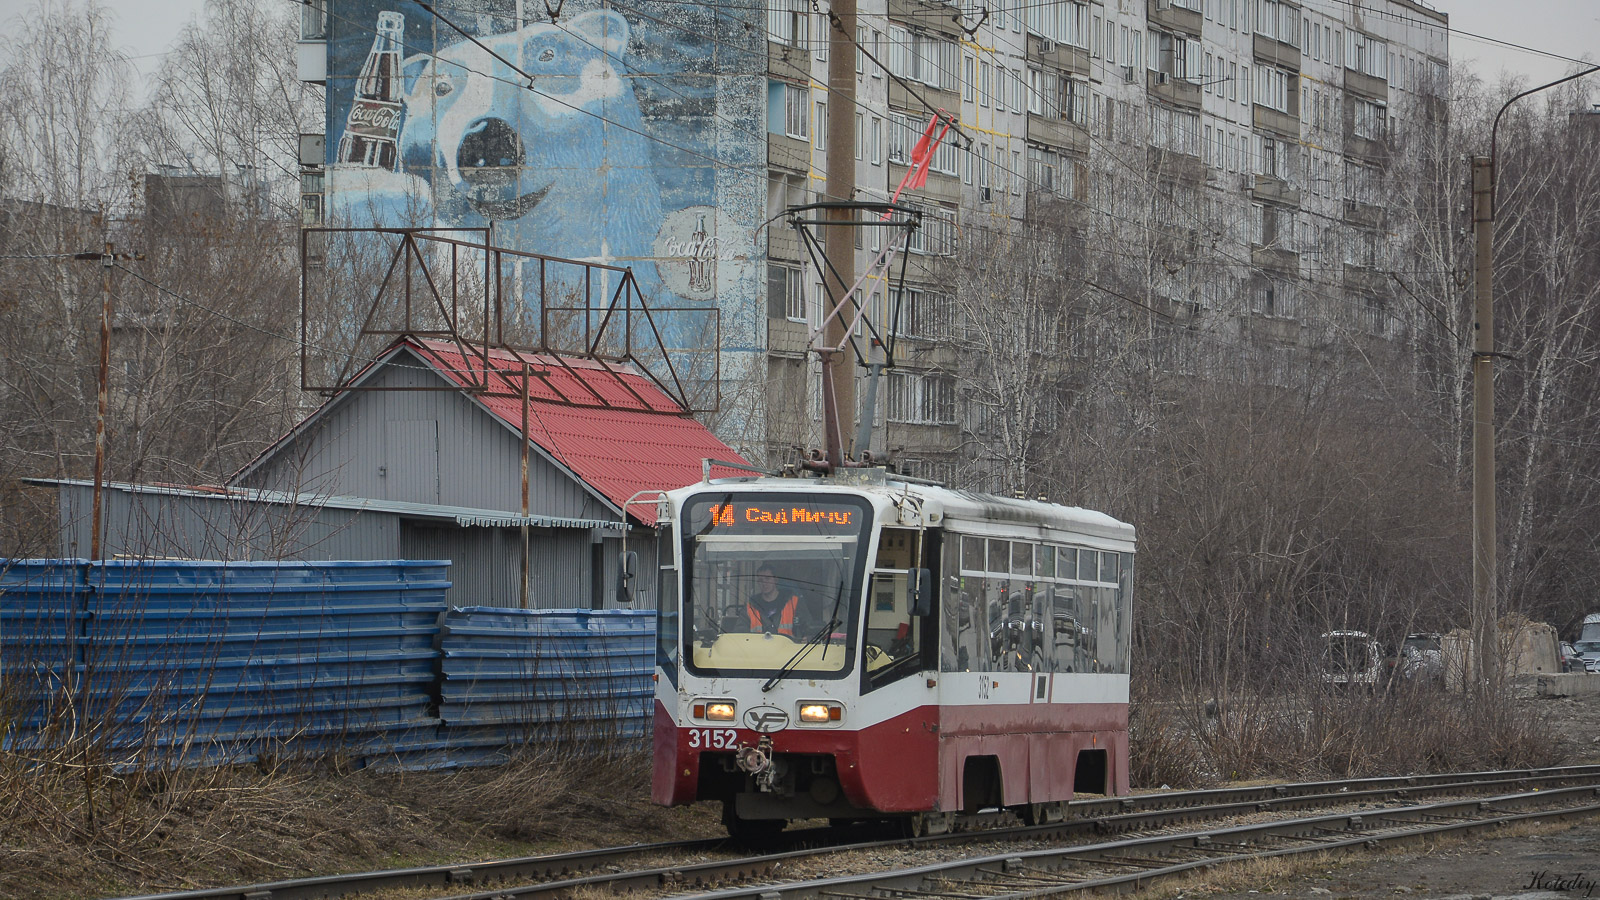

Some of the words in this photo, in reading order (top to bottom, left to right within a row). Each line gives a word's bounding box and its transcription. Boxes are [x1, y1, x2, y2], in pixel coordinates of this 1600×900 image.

[709, 504, 735, 527] 14
[745, 507, 788, 524] Сад
[688, 729, 737, 750] 3152
